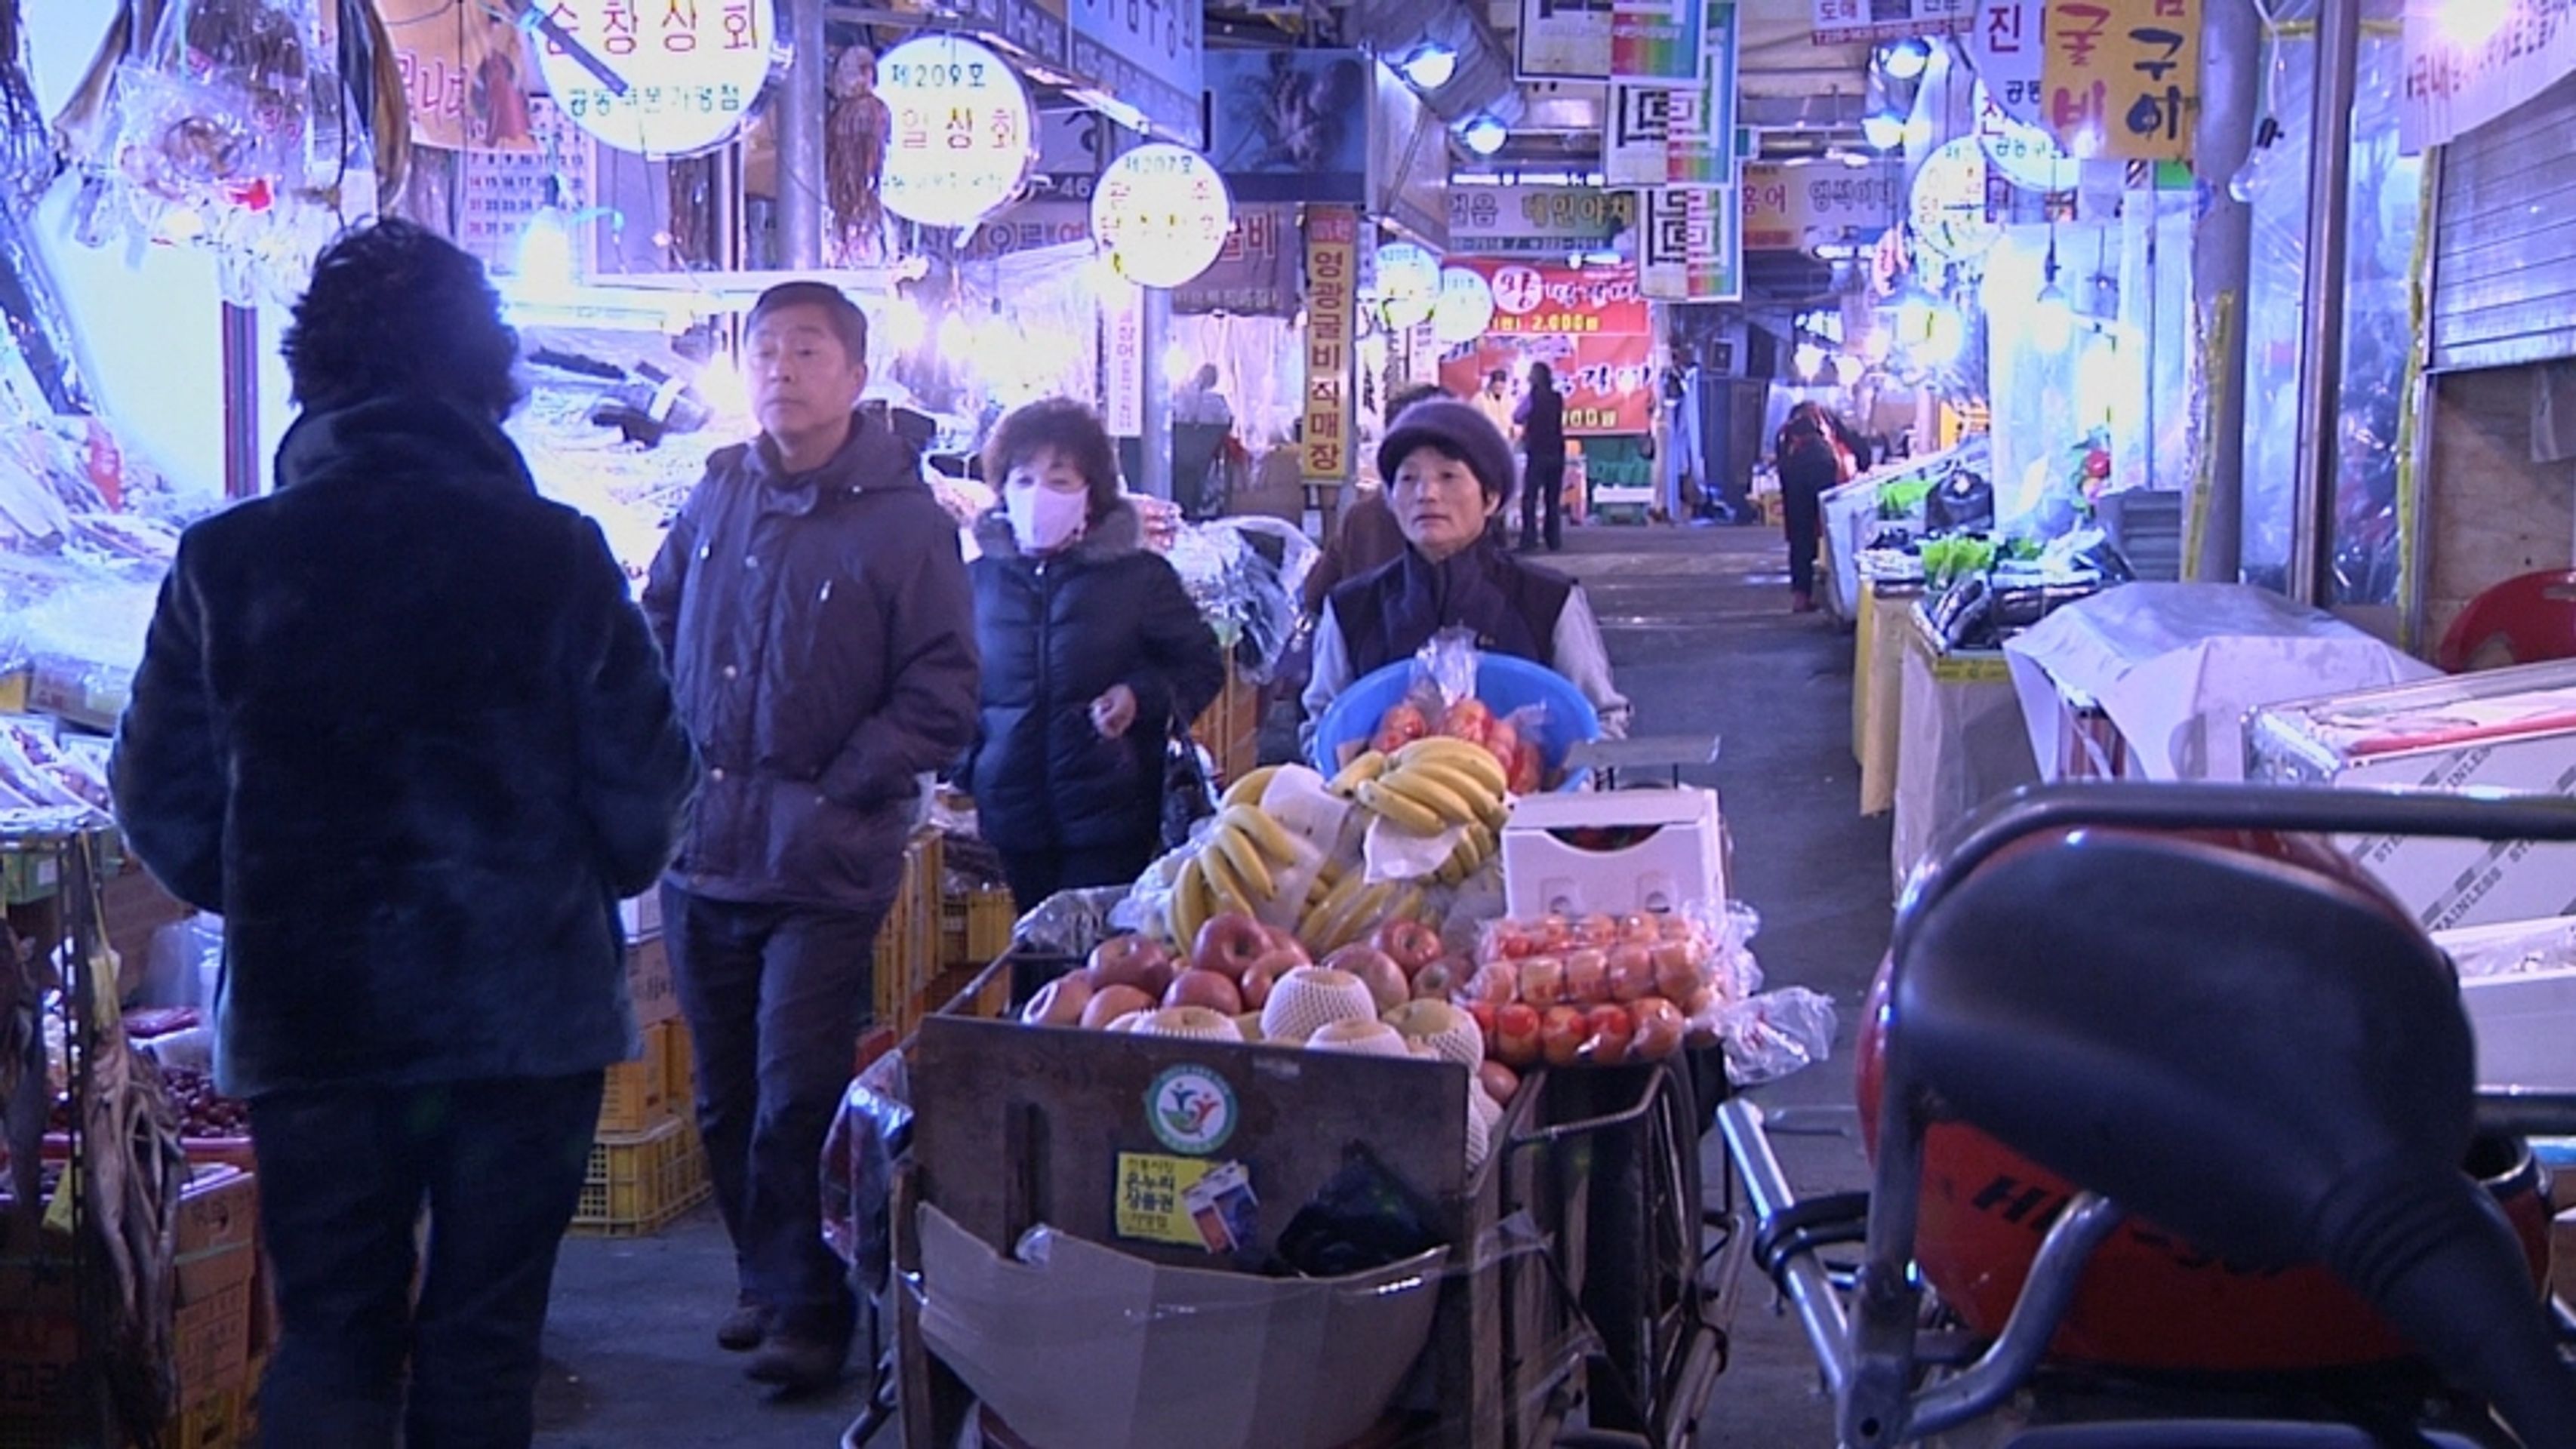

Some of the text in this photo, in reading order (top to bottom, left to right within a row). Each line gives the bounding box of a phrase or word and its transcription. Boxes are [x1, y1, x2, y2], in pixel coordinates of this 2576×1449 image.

[891, 63, 986, 87] 제209호
[1310, 251, 1344, 470] 영광굴비직매장
[2433, 866, 2503, 931] TAINLESS
